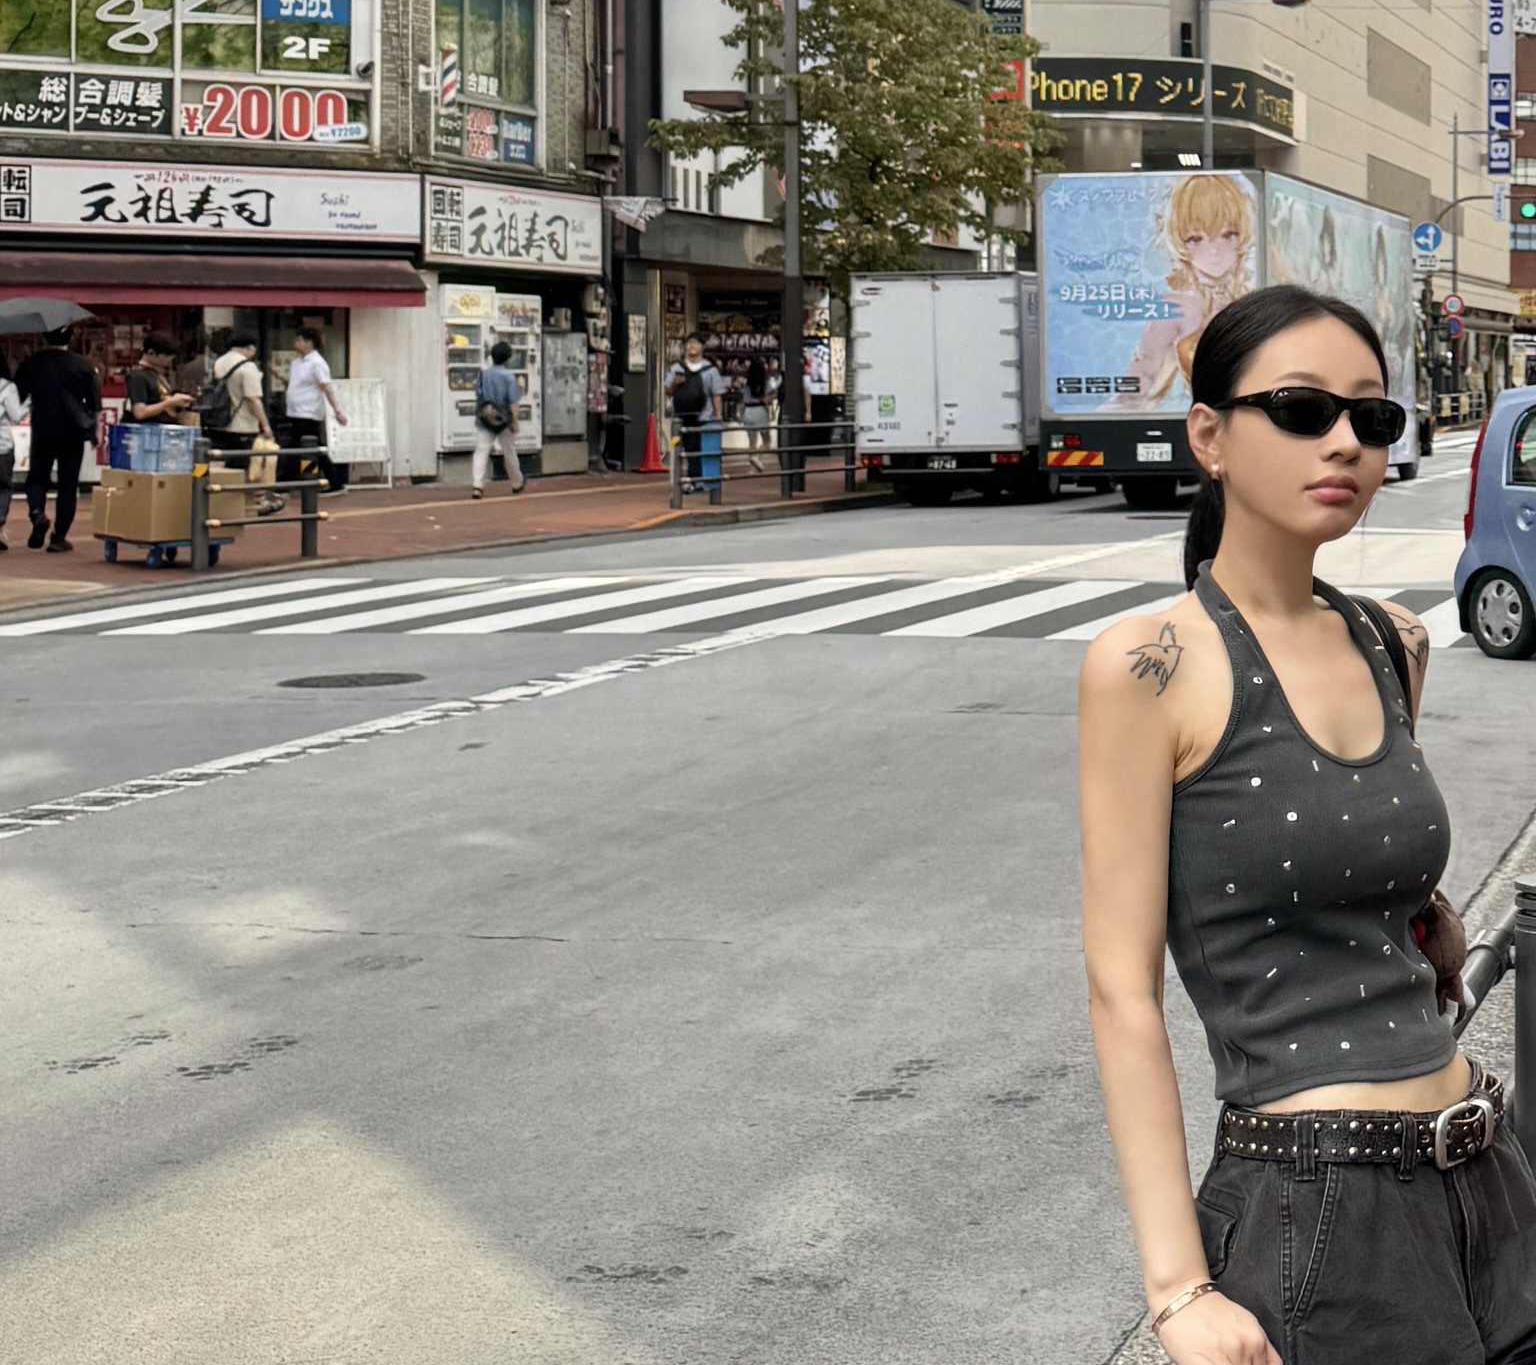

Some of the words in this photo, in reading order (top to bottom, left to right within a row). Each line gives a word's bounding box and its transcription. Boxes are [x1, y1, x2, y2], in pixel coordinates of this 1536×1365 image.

[282, 37, 330, 60] 2F
[38, 76, 163, 108] 総合調髪
[79, 183, 275, 228] 元祖寿司
[468, 205, 568, 262] 元祖寿司
[1060, 284, 1155, 301] 9月25日(木)
